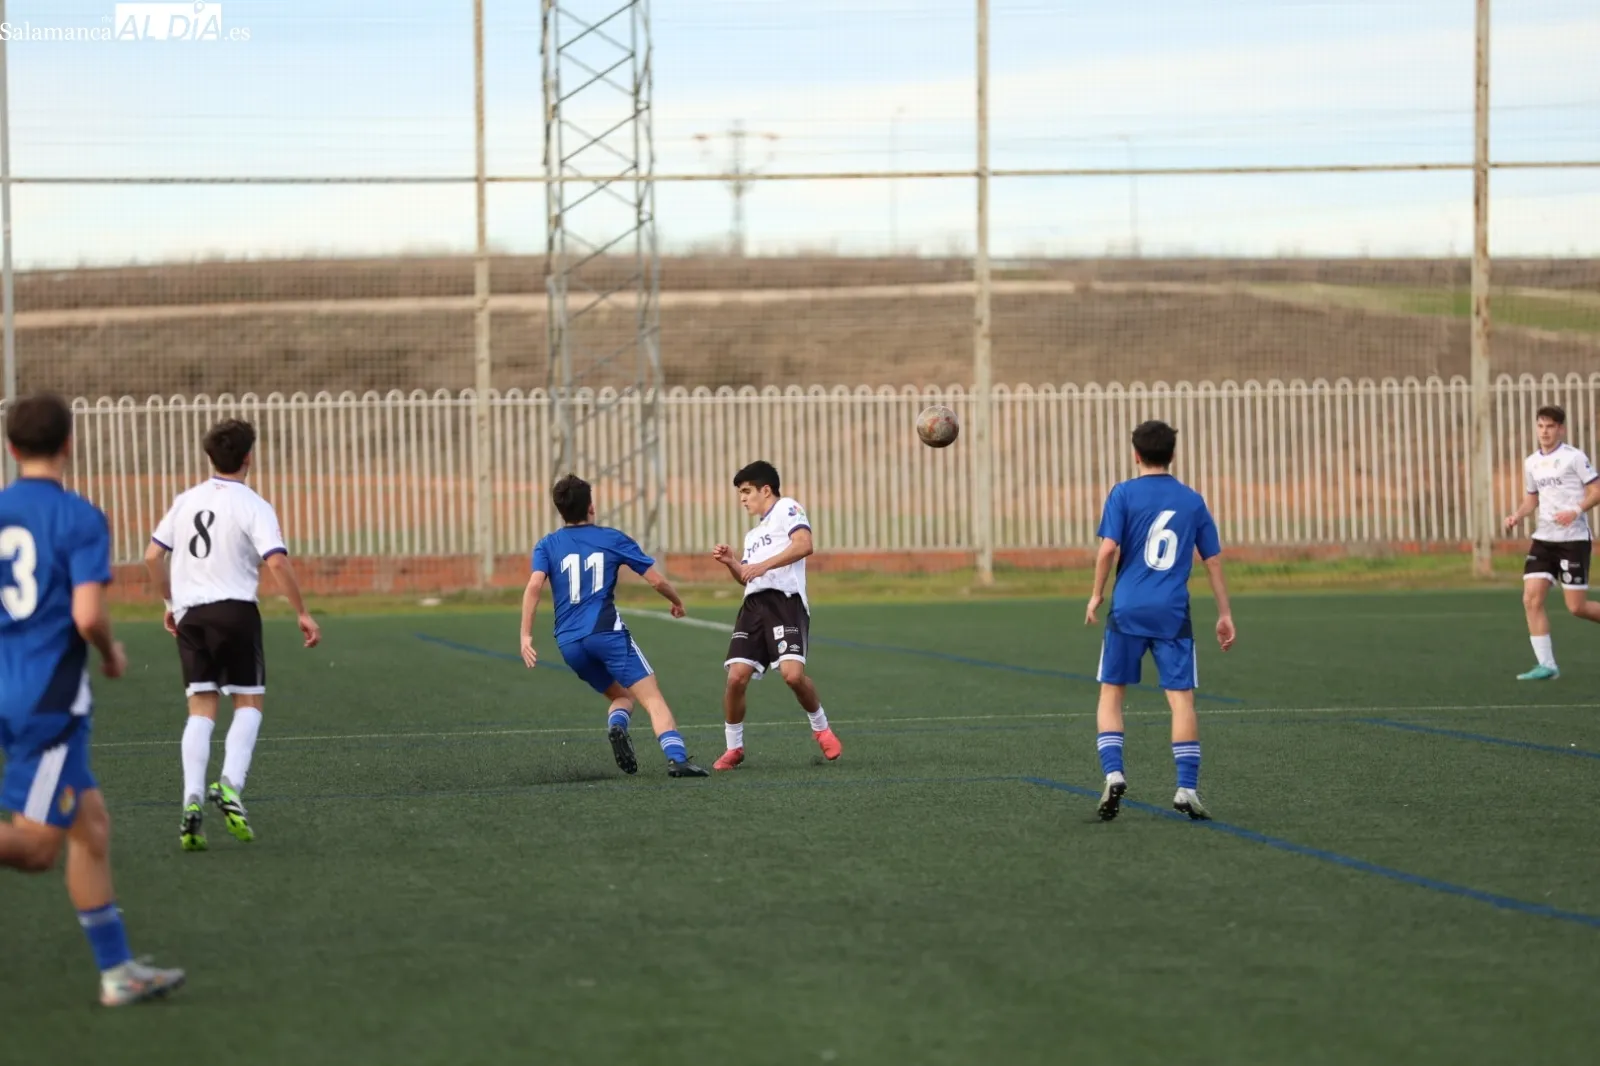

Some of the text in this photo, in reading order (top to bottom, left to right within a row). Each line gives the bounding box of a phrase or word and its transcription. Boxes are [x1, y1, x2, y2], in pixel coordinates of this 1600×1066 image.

[189, 509, 215, 559] 8
[1143, 509, 1179, 571] 6
[0, 525, 38, 622] 3
[560, 552, 605, 605] 11
